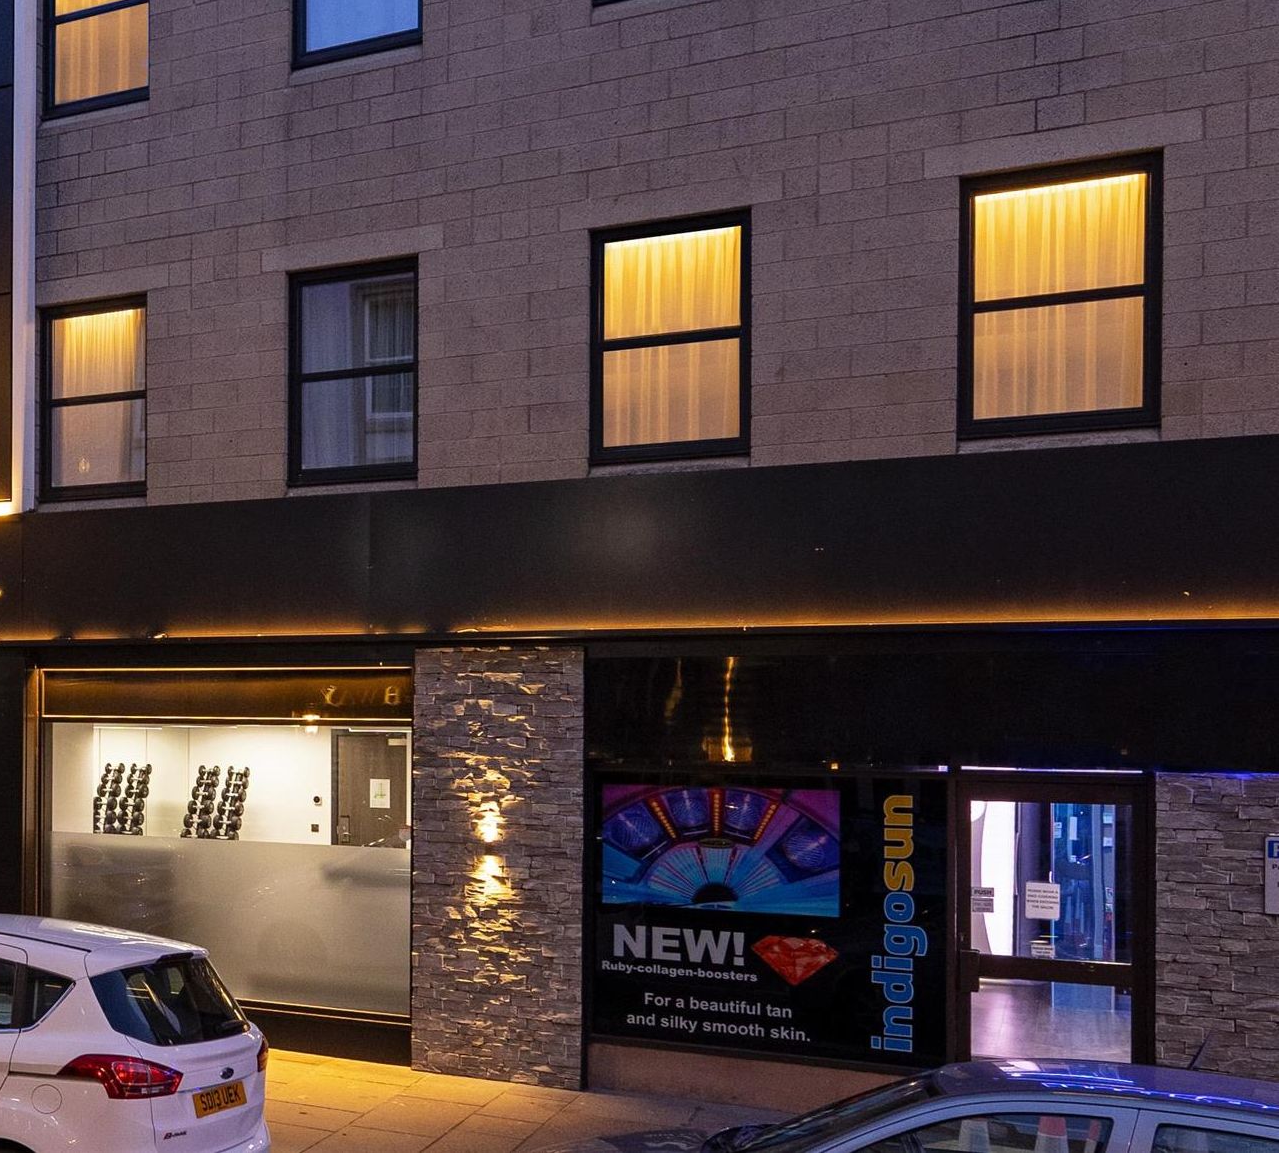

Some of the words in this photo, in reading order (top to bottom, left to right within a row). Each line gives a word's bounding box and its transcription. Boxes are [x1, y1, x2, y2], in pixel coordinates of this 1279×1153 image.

[871, 794, 928, 1053] indigosun
[613, 924, 745, 966] NEW!
[601, 960, 758, 982] Ruby-collagen-boosters
[644, 992, 671, 1007] For
[675, 997, 684, 1008] a
[689, 997, 761, 1016] beautiful
[766, 1004, 792, 1018] tan
[626, 1013, 656, 1026] and
[660, 1015, 698, 1033] silky
[702, 1020, 764, 1037] smooth
[770, 1026, 811, 1042] skin.
[200, 1091, 222, 1112] SD13
[222, 1085, 241, 1105] UEK
